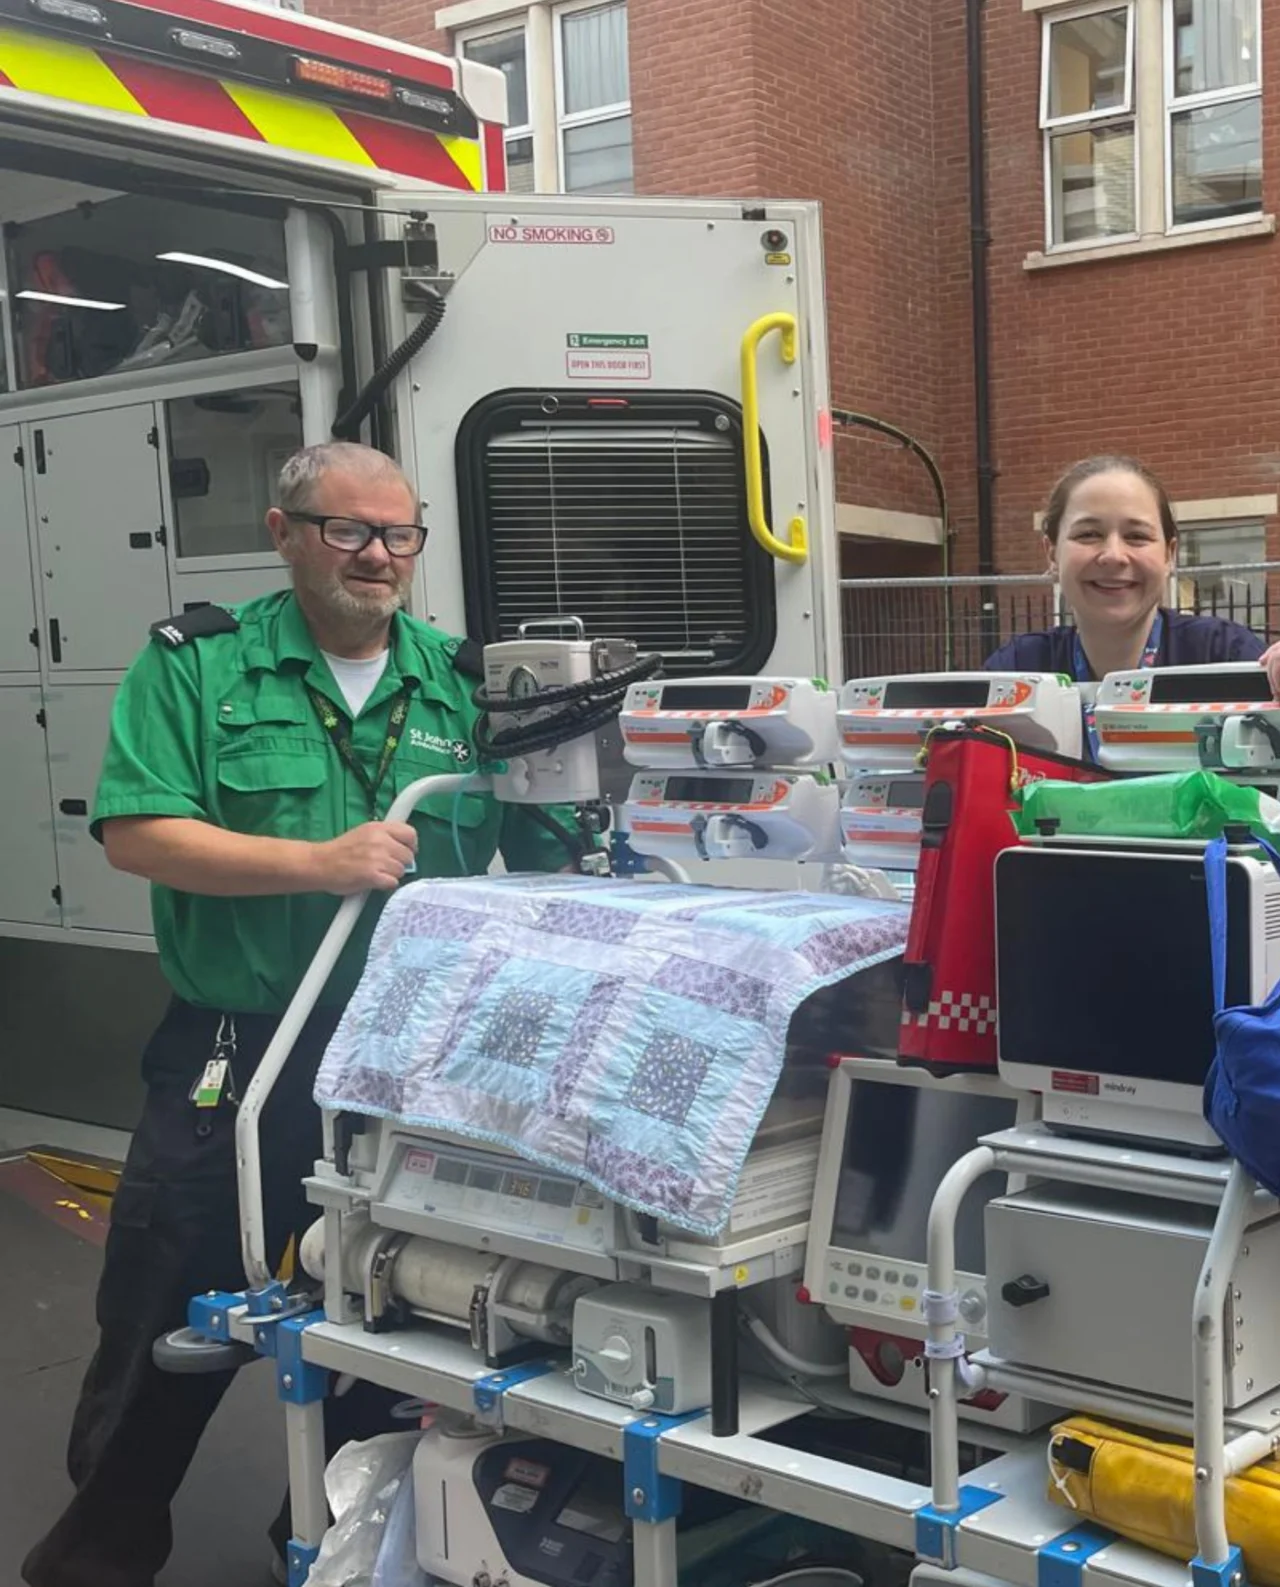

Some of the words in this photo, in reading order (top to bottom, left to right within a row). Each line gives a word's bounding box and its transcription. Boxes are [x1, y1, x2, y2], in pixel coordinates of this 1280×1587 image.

[494, 227, 517, 239] NO
[522, 228, 593, 241] SMOKING
[582, 336, 627, 346] Emergency
[629, 337, 646, 346] Exit
[410, 728, 422, 740] St
[424, 731, 451, 747] John
[1103, 1082, 1137, 1095] mindray
